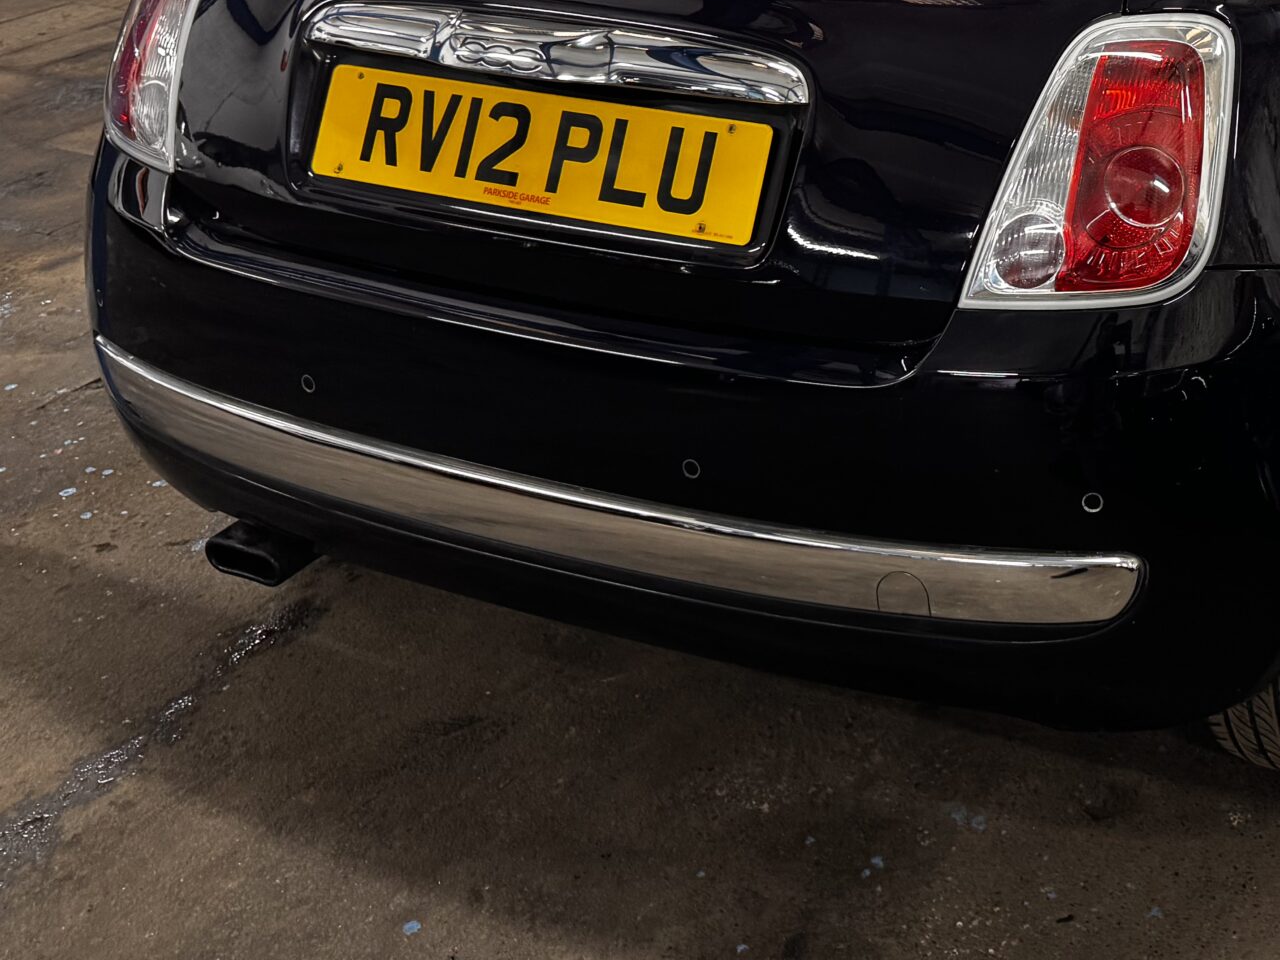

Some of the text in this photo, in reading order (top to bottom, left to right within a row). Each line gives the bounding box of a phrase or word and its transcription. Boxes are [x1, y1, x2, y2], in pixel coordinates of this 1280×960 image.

[359, 82, 718, 216] RV12 PLU
[483, 186, 519, 200] PARKSIDE
[519, 193, 552, 206] GARAGE
